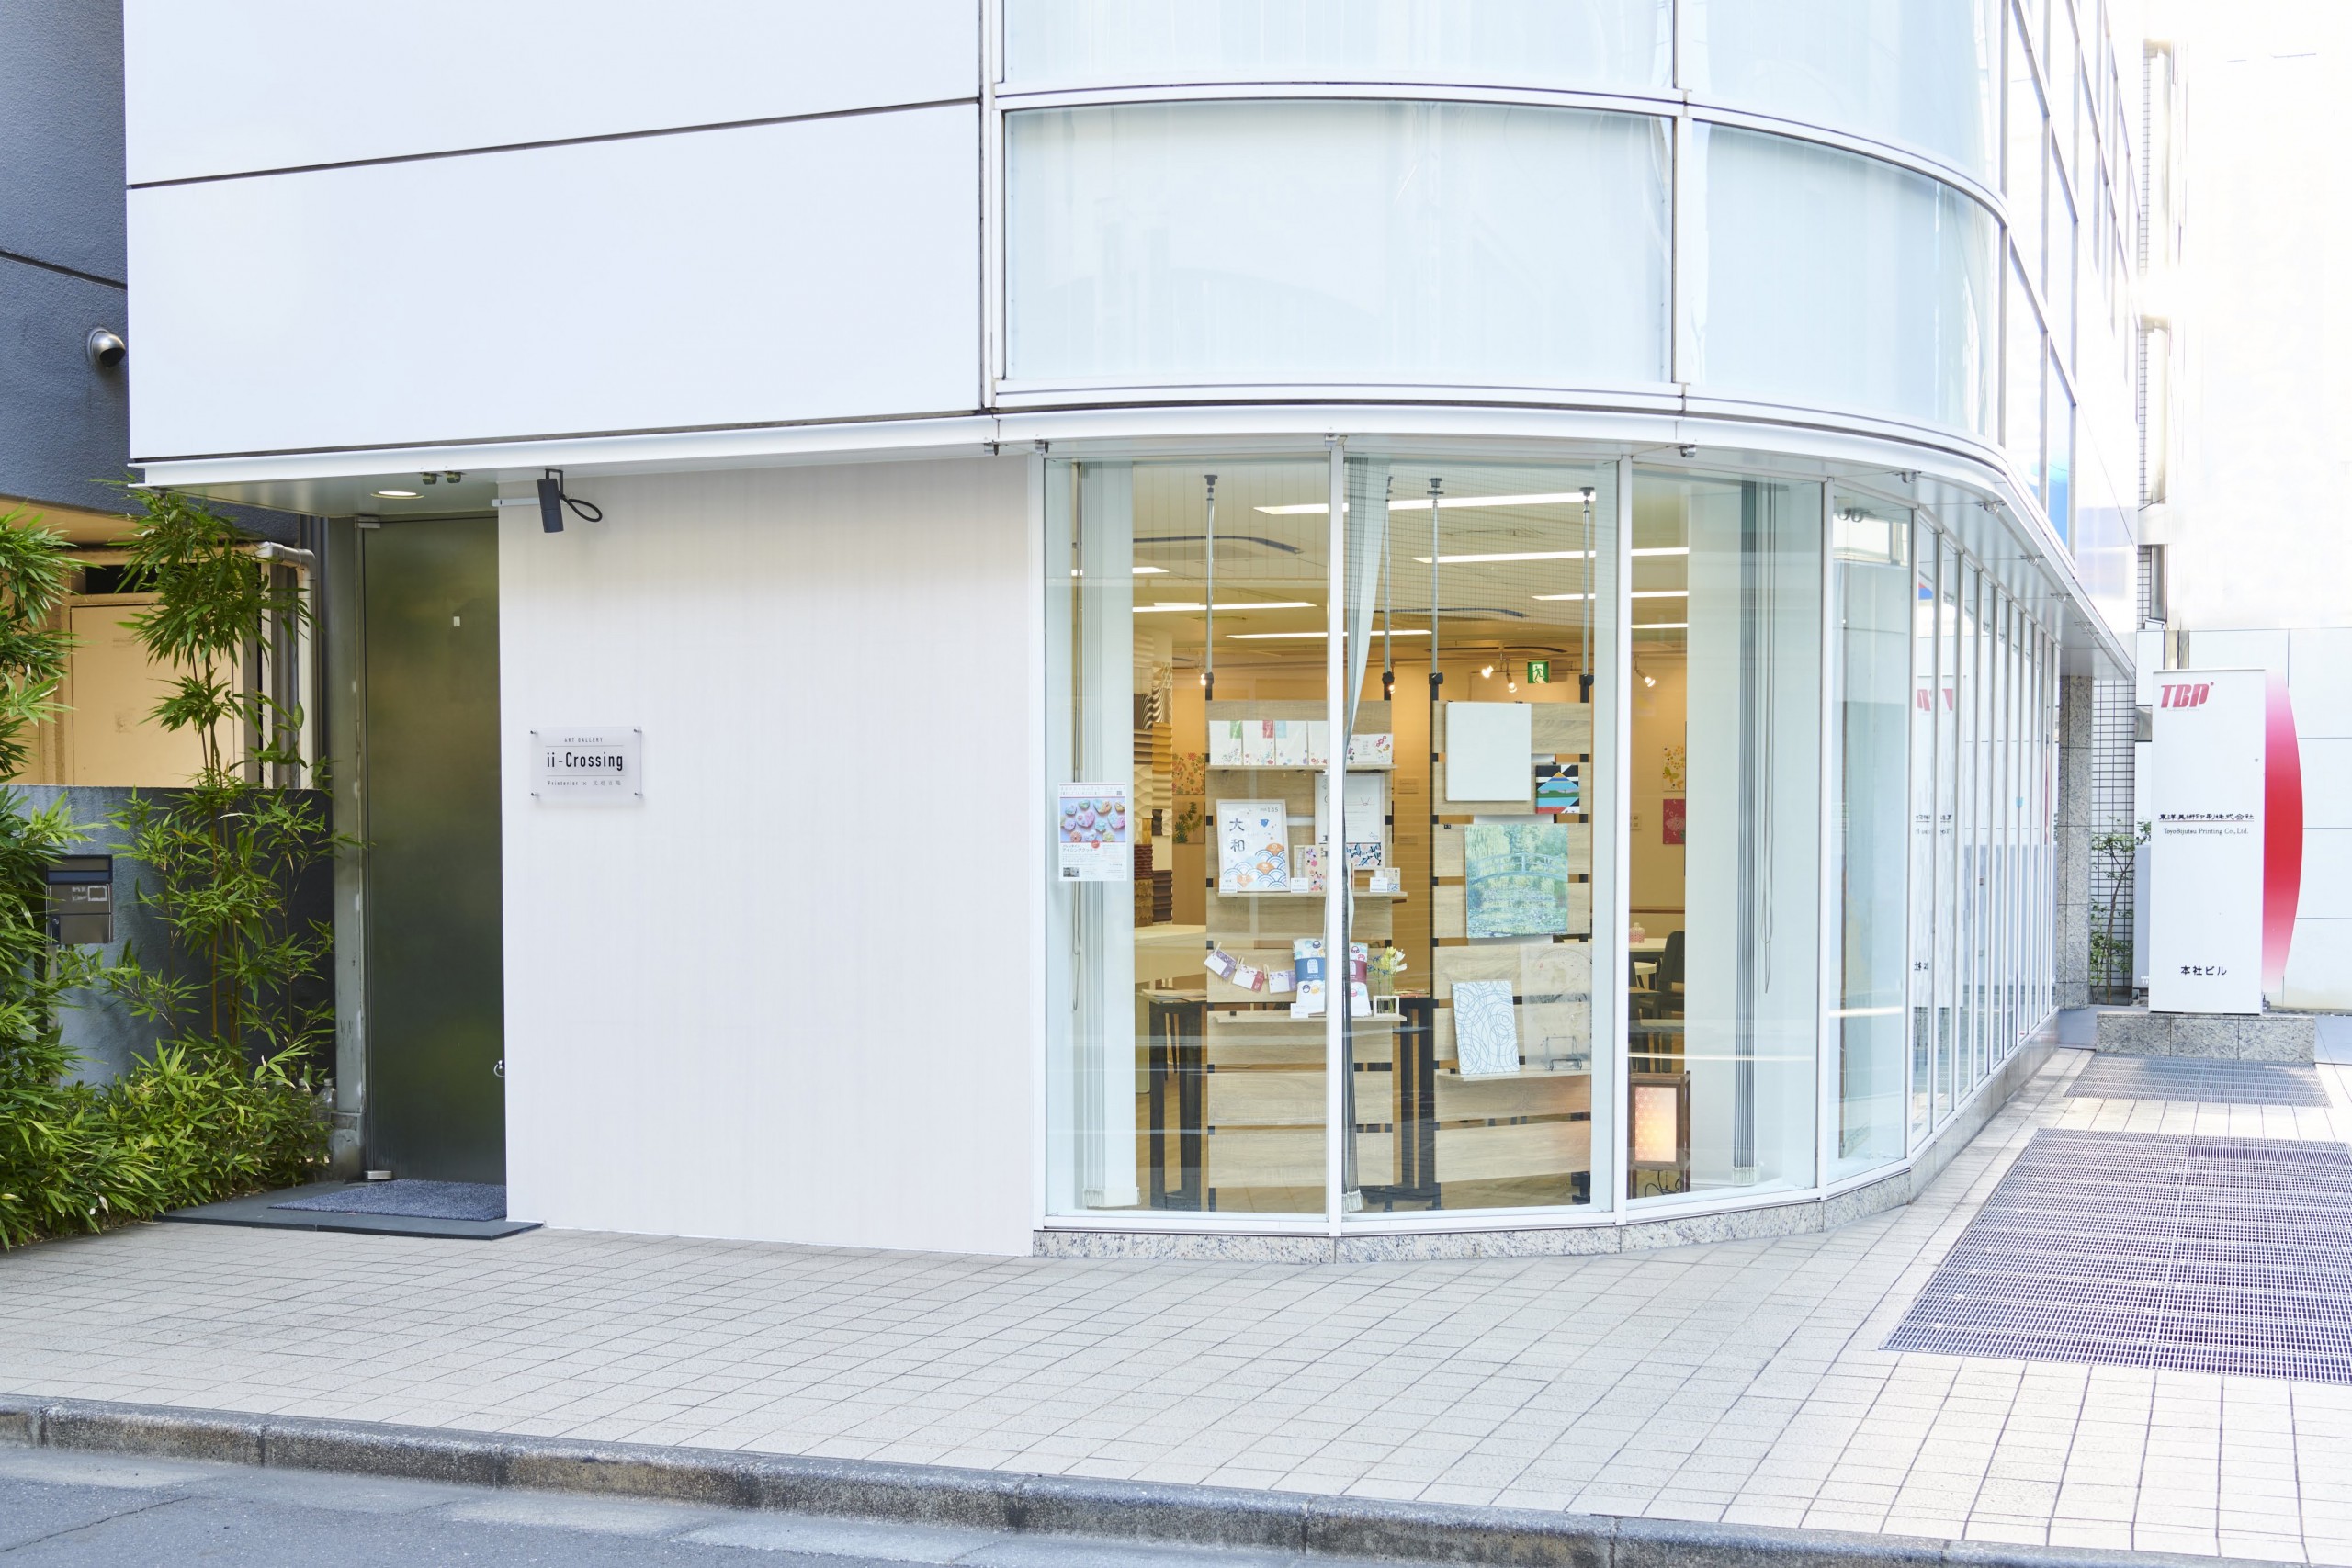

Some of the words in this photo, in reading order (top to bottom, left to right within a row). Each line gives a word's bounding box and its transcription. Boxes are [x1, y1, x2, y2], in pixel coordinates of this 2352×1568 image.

[547, 751, 623, 772] ii-Crossing
[2164, 828, 2197, 836] ToyoBijutsu
[2199, 828, 2222, 836] Printing
[2180, 965, 2227, 976] 本社ビル
